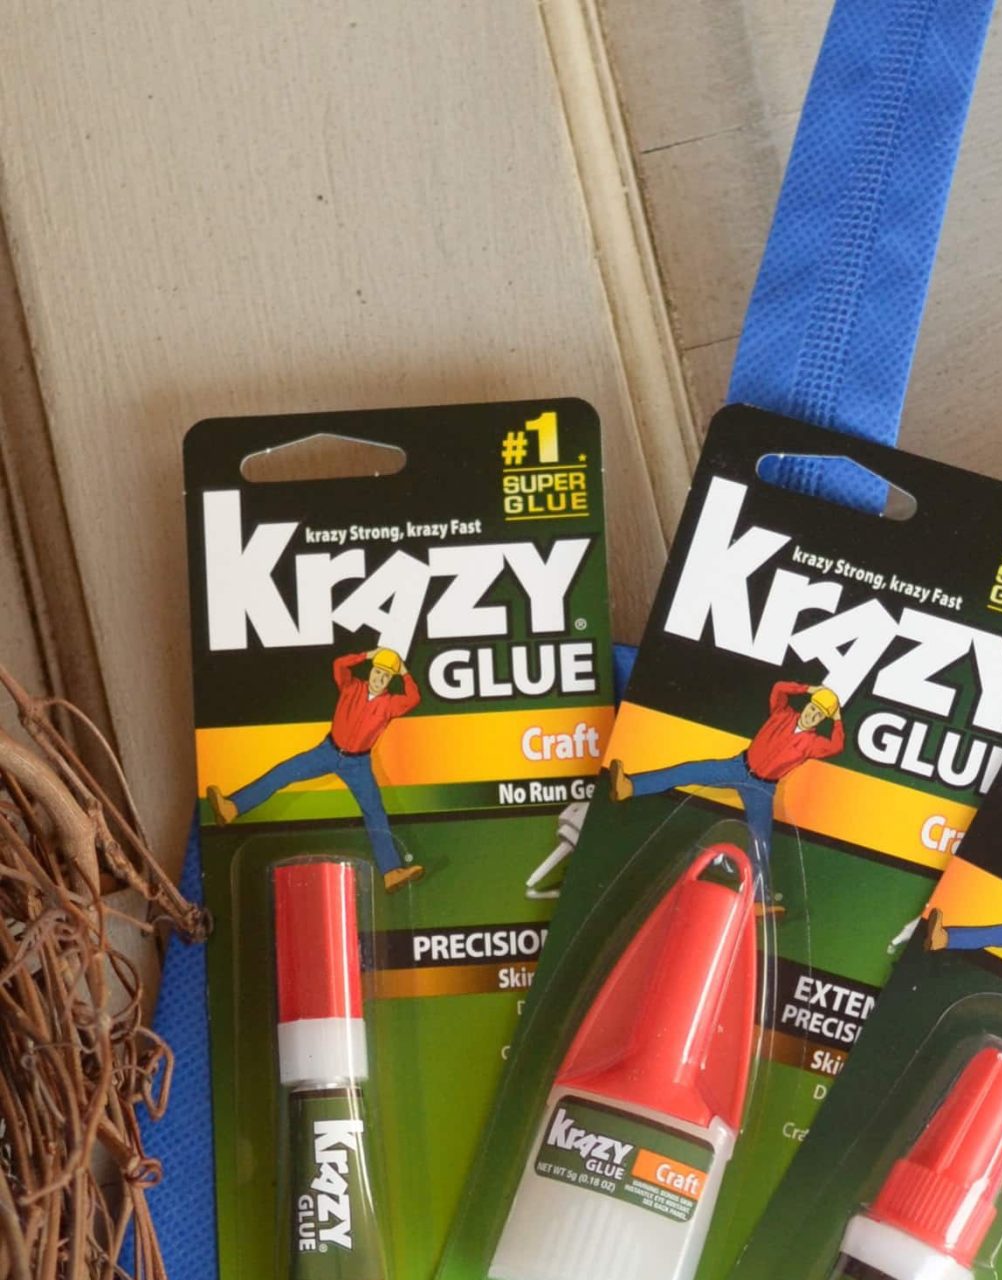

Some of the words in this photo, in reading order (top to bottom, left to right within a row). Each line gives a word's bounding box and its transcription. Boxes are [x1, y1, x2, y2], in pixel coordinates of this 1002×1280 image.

[503, 472, 586, 494] SUPER
[504, 492, 588, 514] GLUE
[350, 524, 404, 542] Strong,
[450, 519, 482, 535] Fast
[834, 559, 887, 590] Strong,
[931, 588, 963, 611] Fast
[428, 642, 596, 700] GLUE
[522, 722, 600, 761] Craft
[499, 783, 526, 805] No
[529, 781, 568, 803] Run
[570, 779, 595, 800] Ge
[810, 1050, 844, 1075] Ski
[585, 1159, 625, 1180] GLUE
[656, 1163, 700, 1195] Craft
[298, 1195, 316, 1251] GLUE
